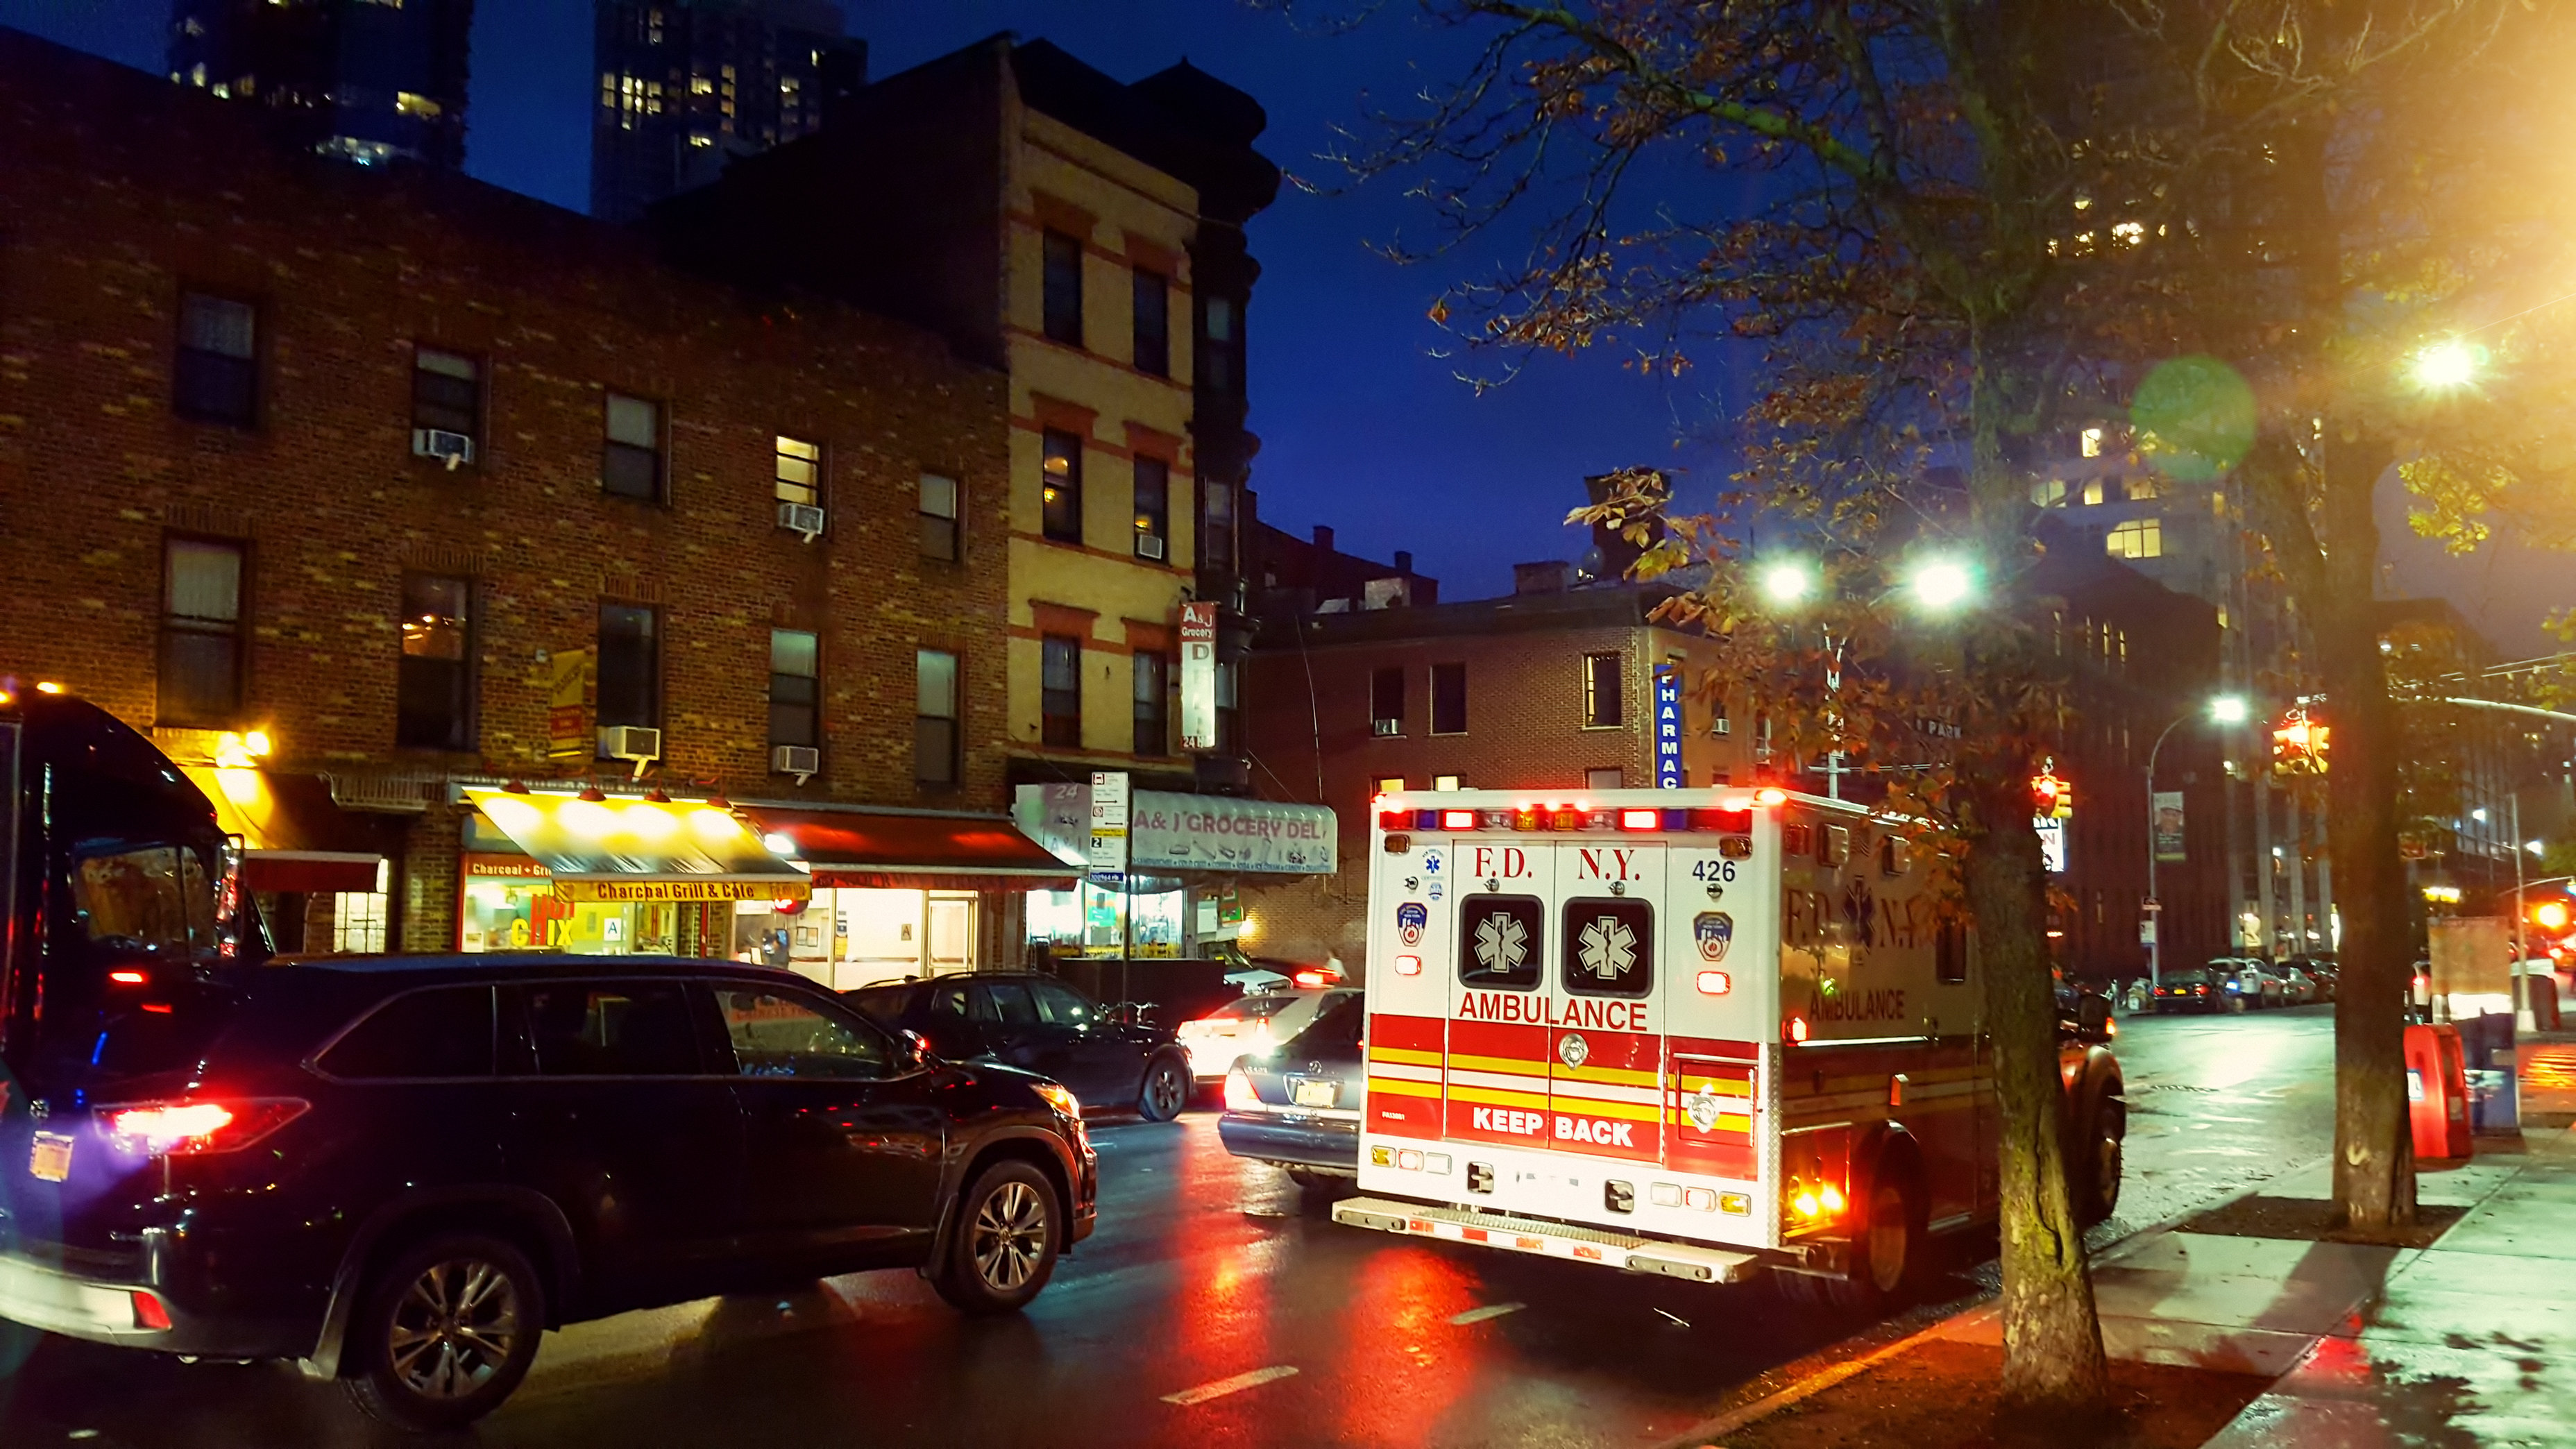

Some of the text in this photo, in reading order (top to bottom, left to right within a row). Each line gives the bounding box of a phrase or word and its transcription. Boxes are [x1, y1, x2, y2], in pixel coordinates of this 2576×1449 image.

[1182, 627, 1213, 638] Grocery
[1055, 784, 1078, 799] 24
[1187, 814, 1282, 838] GROCERY
[1092, 838, 1101, 847] 2
[473, 863, 521, 876] Charcoal
[1475, 847, 1640, 881] F.D. N.Y.
[1692, 861, 1736, 882] 426
[673, 883, 704, 899] Grill
[708, 884, 719, 898] &
[608, 921, 618, 934] A
[1459, 992, 1647, 1031] AMBULANCE
[1808, 990, 1904, 1022] AMBULANCE
[1473, 1107, 1634, 1147] KEEP BACK
